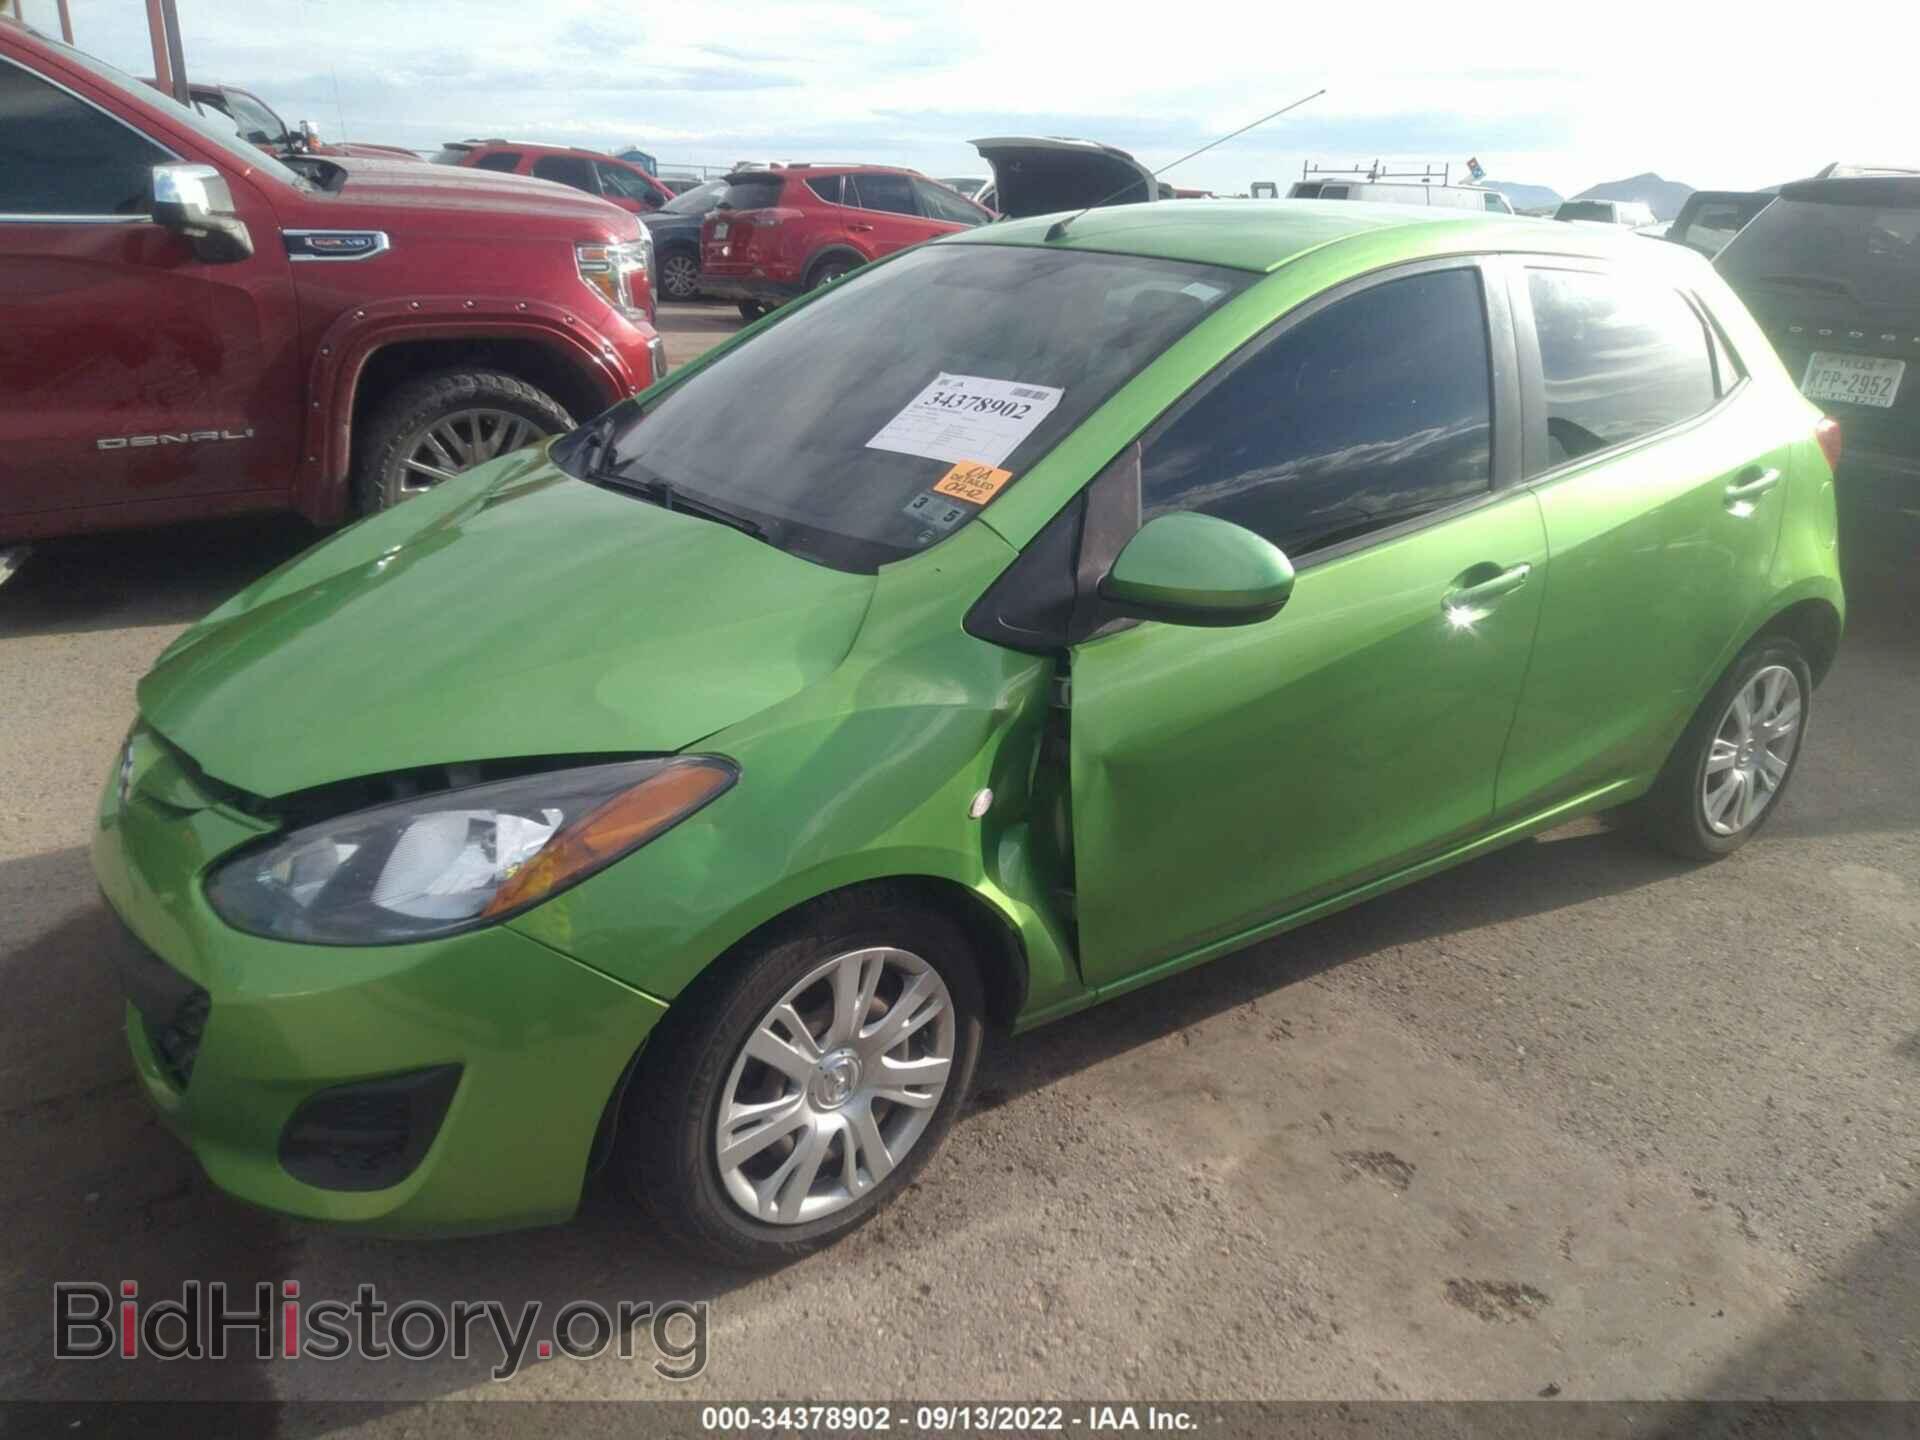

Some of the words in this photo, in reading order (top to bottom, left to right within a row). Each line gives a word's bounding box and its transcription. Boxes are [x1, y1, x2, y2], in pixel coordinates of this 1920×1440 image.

[924, 391, 1032, 419] 34378902
[96, 428, 254, 450] DENALI
[912, 496, 929, 509] 3
[943, 509, 961, 522] 5
